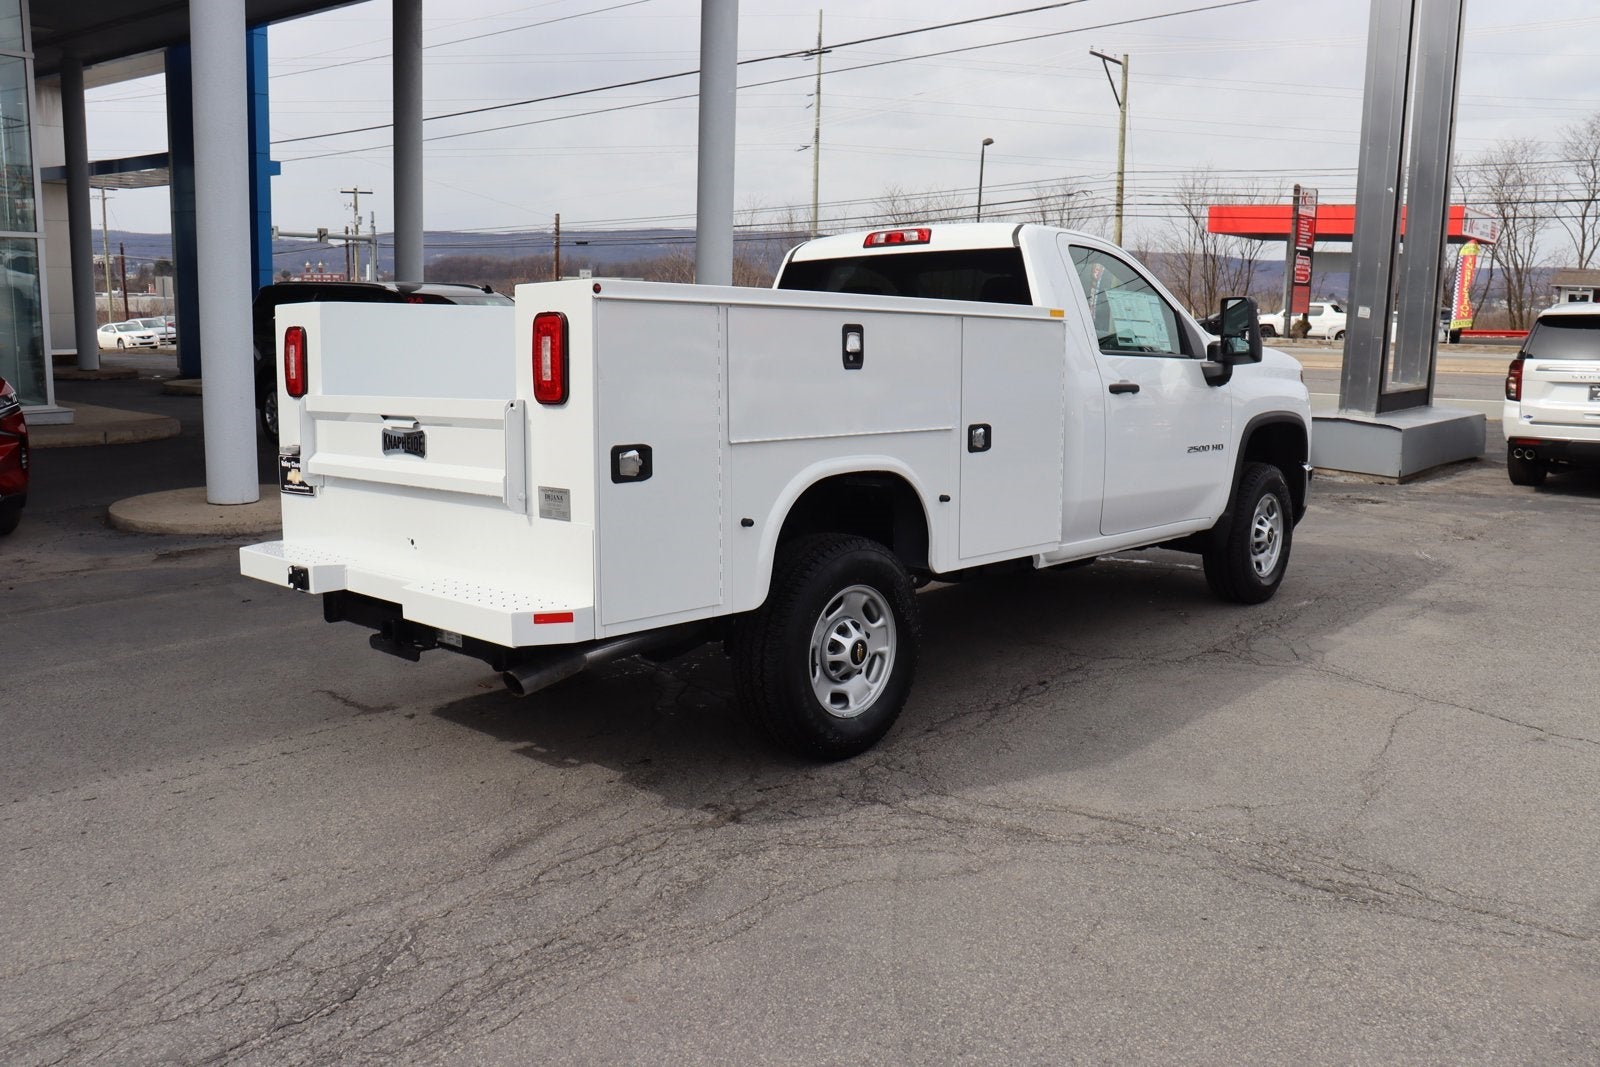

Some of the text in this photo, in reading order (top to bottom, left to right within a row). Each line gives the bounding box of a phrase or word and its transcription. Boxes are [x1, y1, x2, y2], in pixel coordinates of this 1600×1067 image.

[1460, 257, 1474, 317] INSPECTION
[1452, 319, 1472, 328] STATION
[383, 431, 424, 454] KNAPHEIDE
[1187, 443, 1224, 454] 2500 HD
